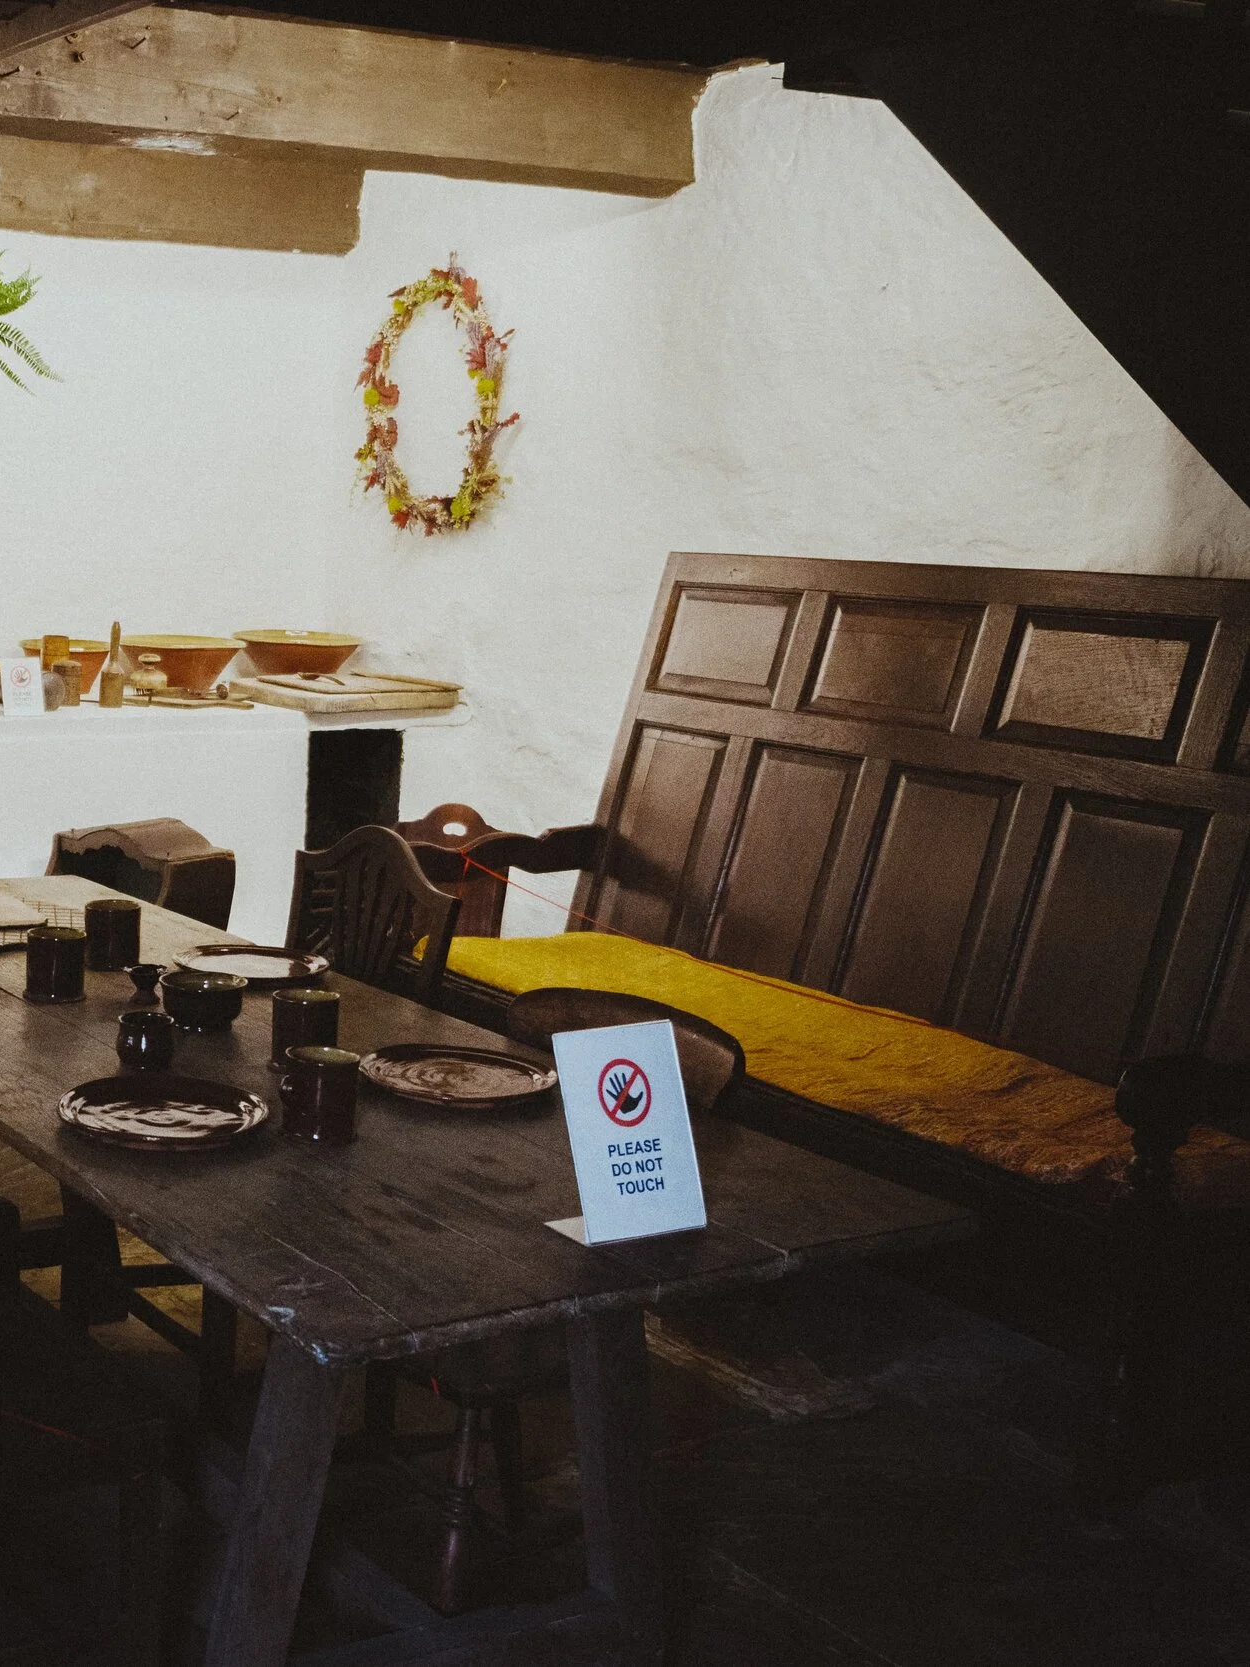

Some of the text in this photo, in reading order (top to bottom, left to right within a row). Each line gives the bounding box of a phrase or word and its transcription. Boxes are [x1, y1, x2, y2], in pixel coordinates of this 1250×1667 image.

[608, 1138, 662, 1158] PLEASE
[611, 1157, 663, 1177] DO NOT
[617, 1177, 665, 1195] TOUCH
